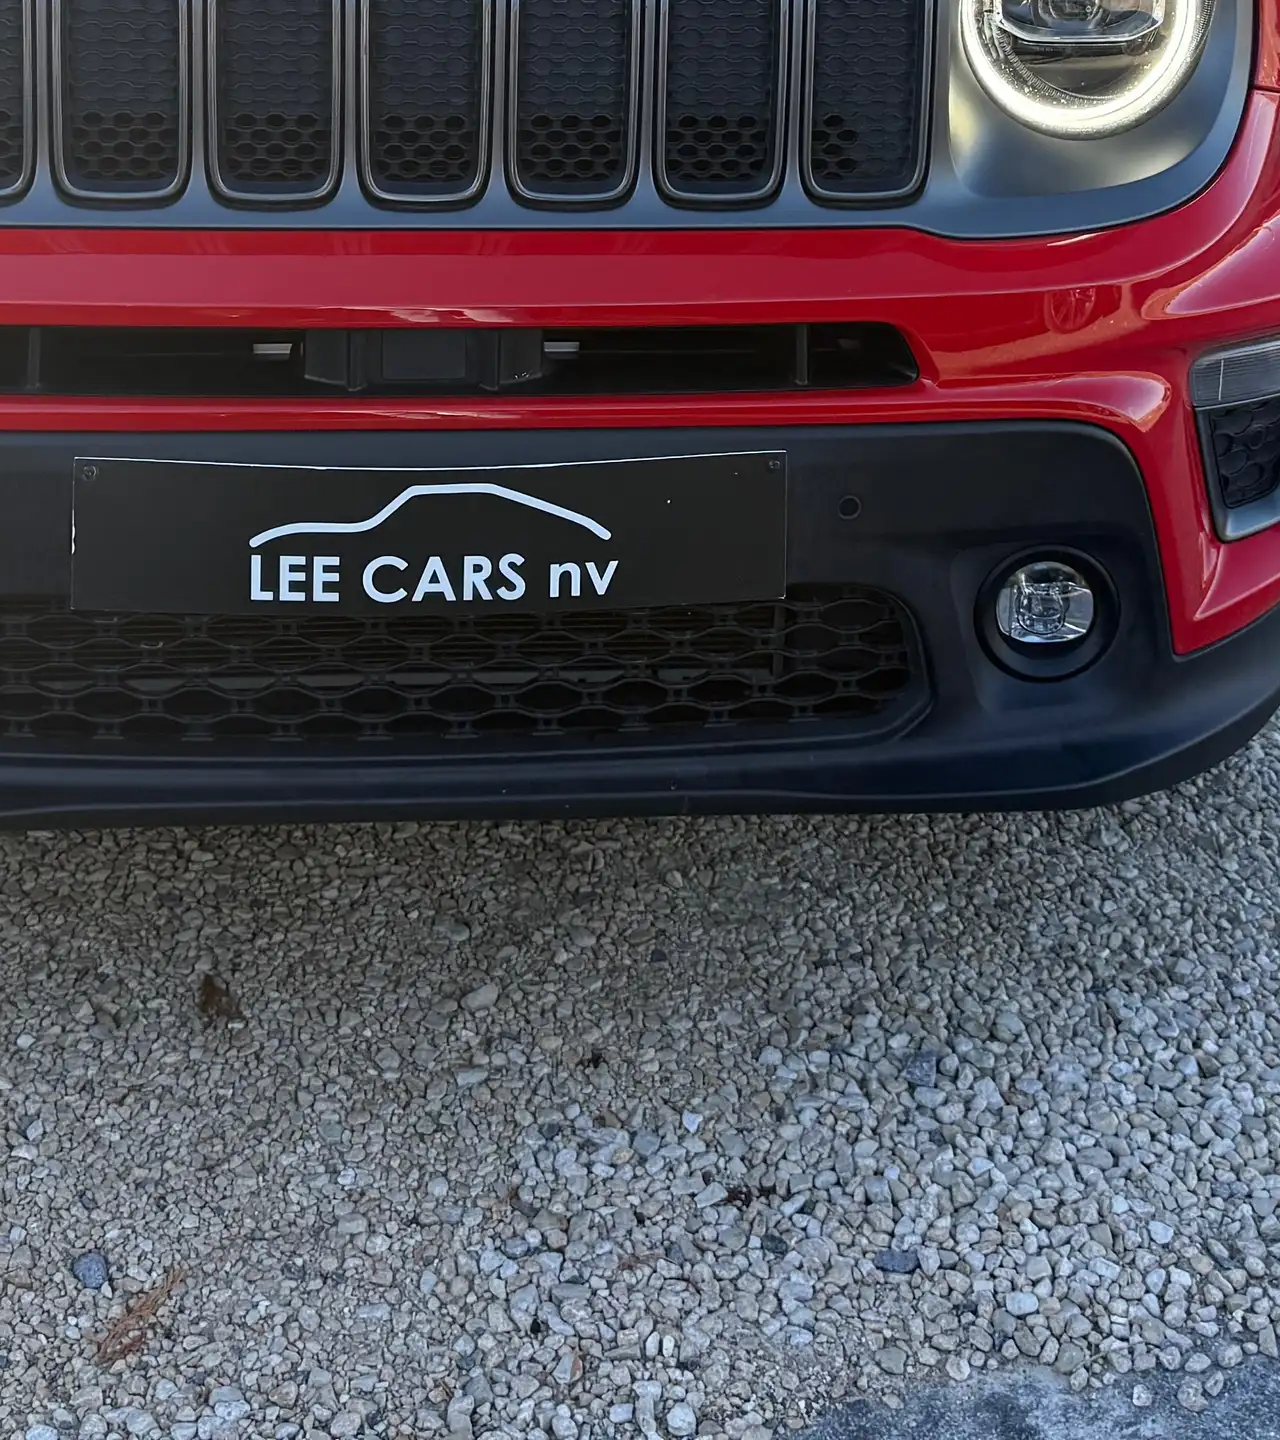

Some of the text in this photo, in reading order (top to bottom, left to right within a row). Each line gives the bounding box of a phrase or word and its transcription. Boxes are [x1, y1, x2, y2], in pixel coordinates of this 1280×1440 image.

[250, 553, 619, 604] LEE CARS nv
